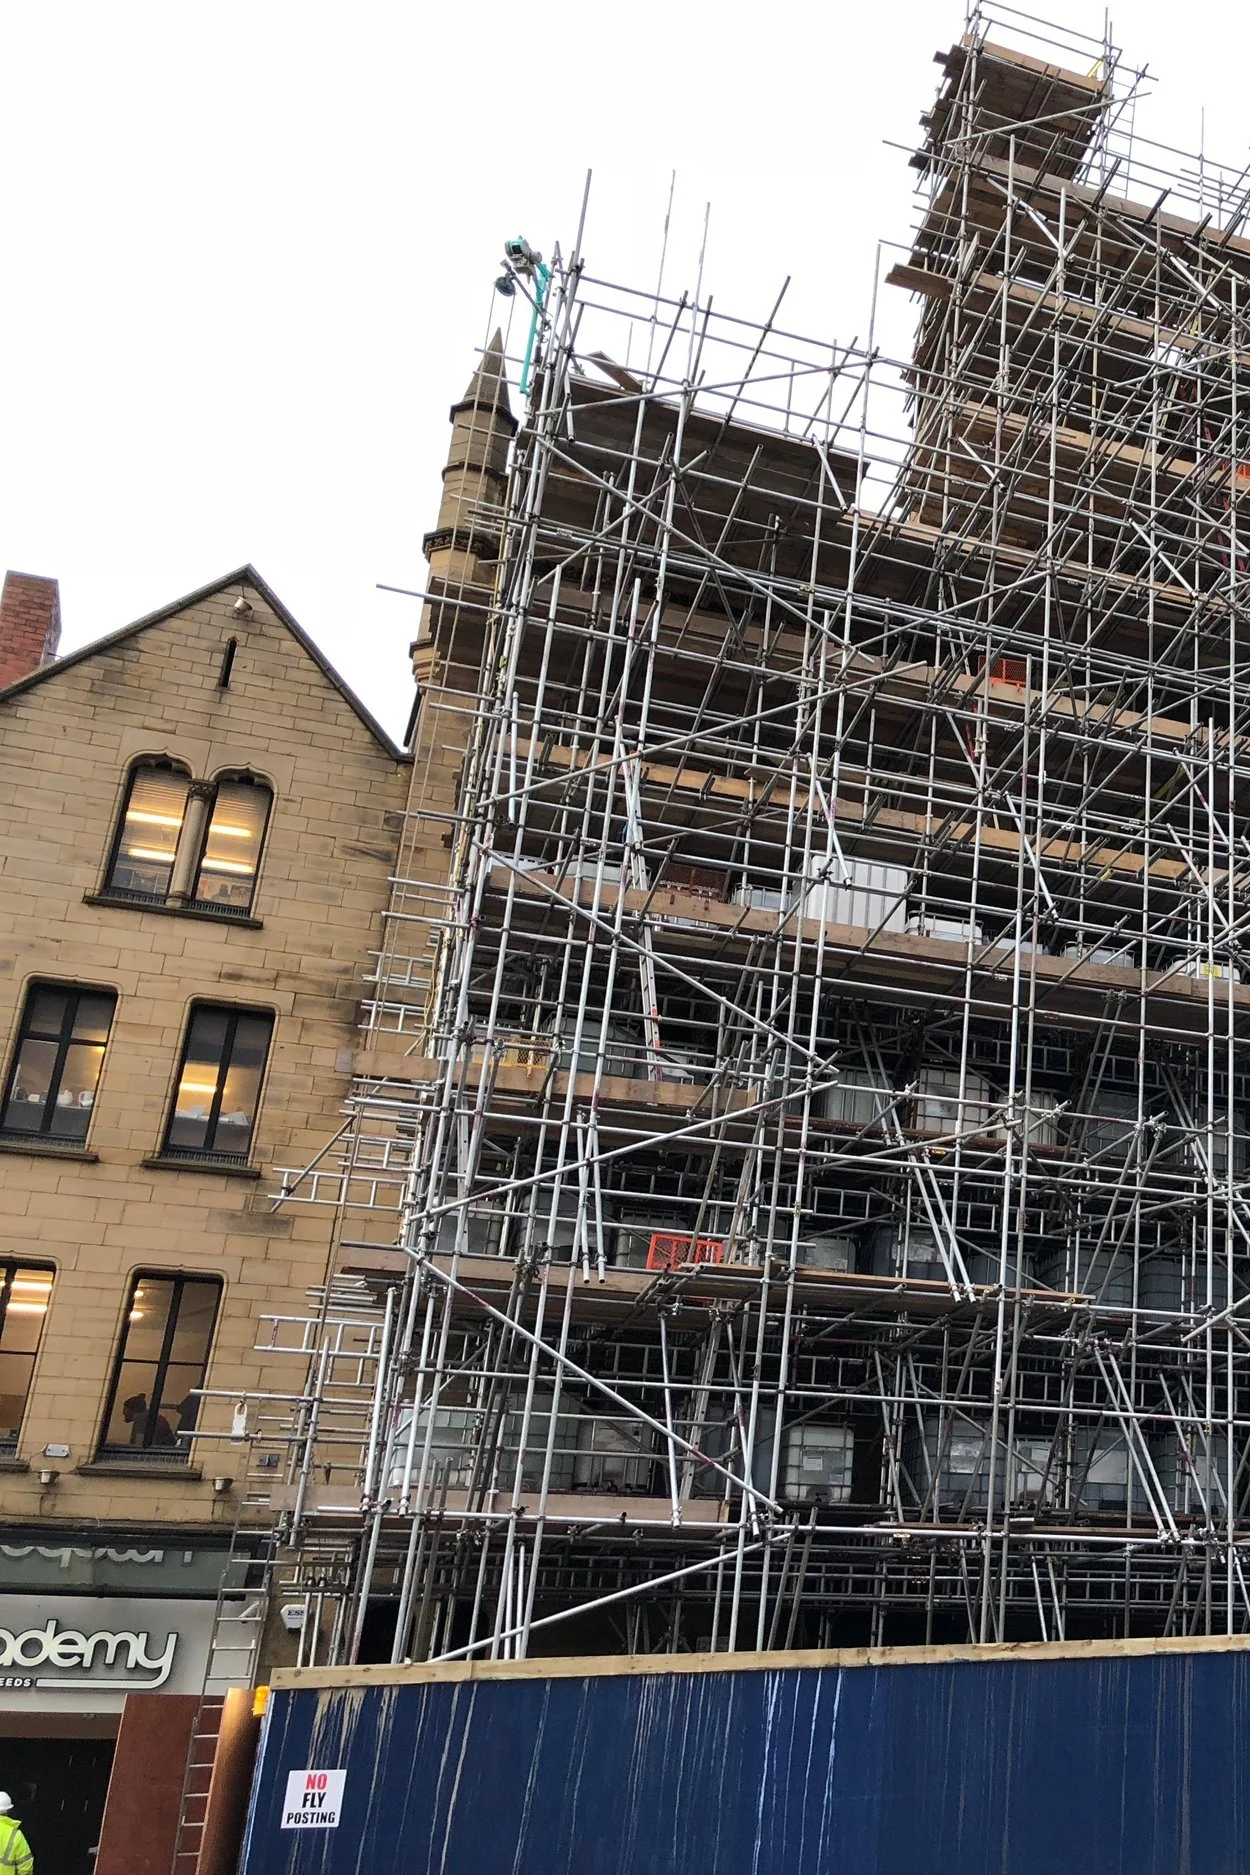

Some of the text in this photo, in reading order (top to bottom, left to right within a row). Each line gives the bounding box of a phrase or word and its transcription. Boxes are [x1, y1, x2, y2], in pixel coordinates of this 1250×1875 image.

[306, 1773, 328, 1790] NO
[302, 1792, 327, 1809] FLY
[286, 1811, 336, 1825] POSTING
